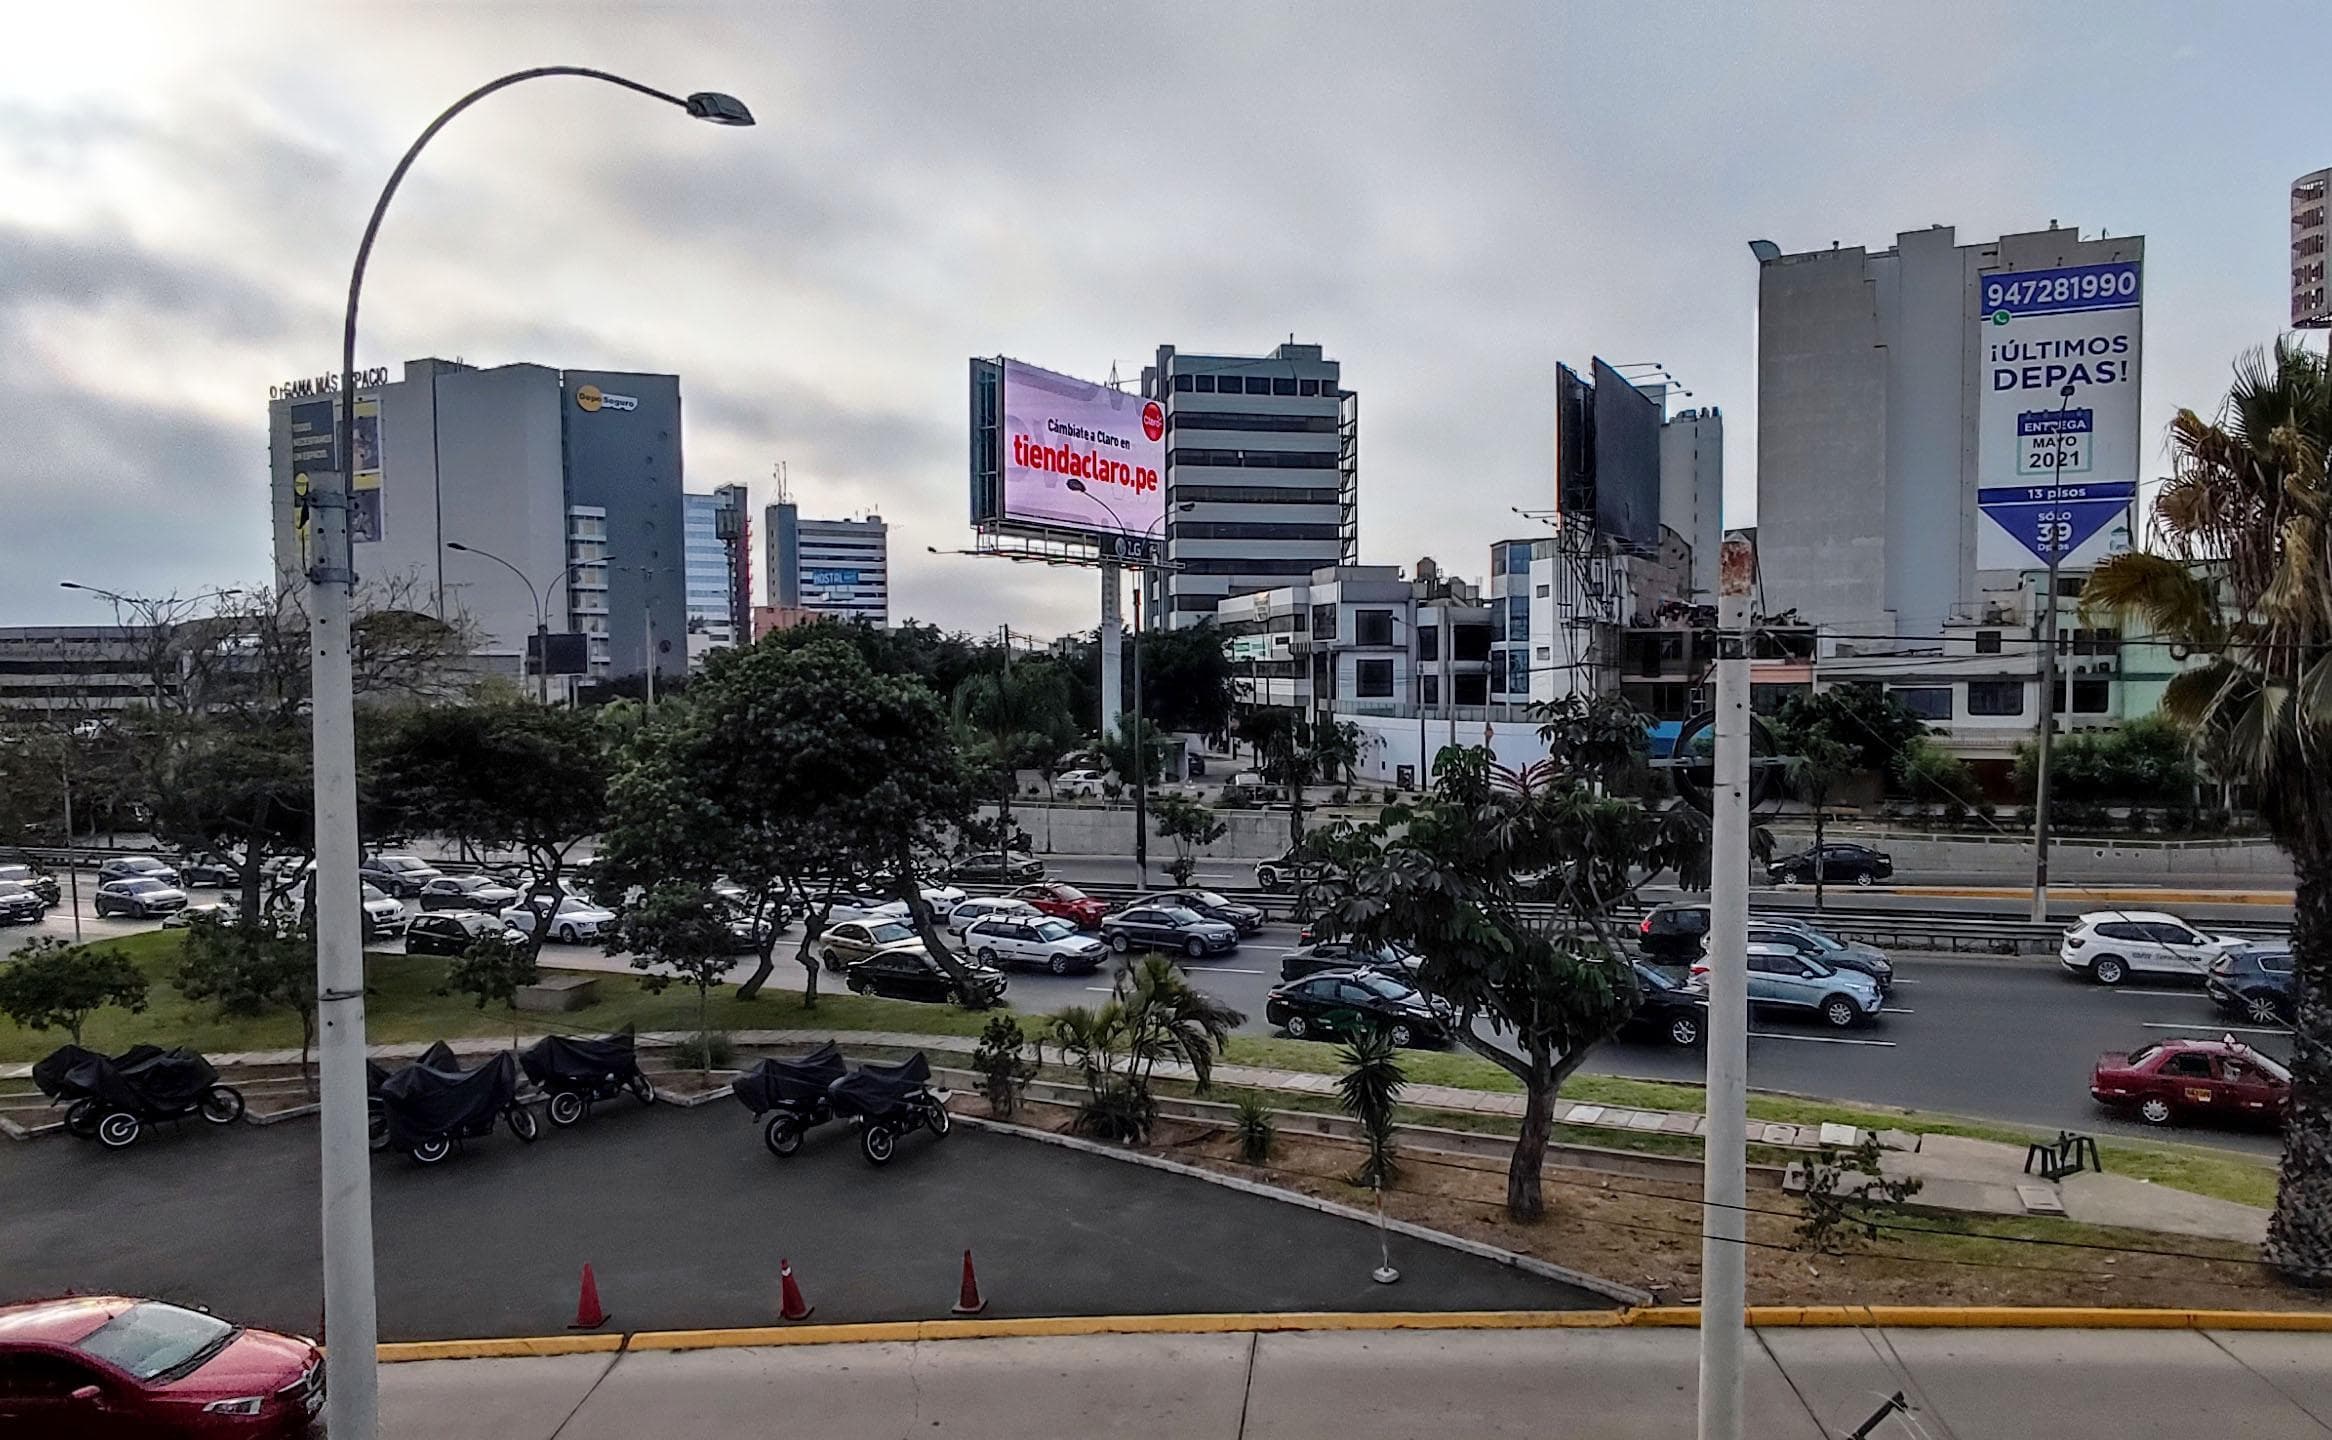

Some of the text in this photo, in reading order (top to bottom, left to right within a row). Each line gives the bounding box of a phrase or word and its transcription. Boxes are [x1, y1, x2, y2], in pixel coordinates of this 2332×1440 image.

[1987, 271, 2136, 307] 947281990
[1991, 335, 2128, 362] ¡ÚLTIMOS
[341, 366, 388, 389] PACIO
[1994, 360, 2128, 391] DEPAS!
[1048, 418, 1131, 450] Cámbiate a Claro en
[2032, 436, 2077, 448] MAYO
[1013, 434, 1158, 495] tiendaclaro.pe
[2029, 450, 2079, 468] 2021
[2028, 487, 2086, 500] 13 pisos
[2037, 522, 2072, 542] 39
[1127, 541, 1142, 557] LG
[2037, 543, 2070, 552] Dpos
